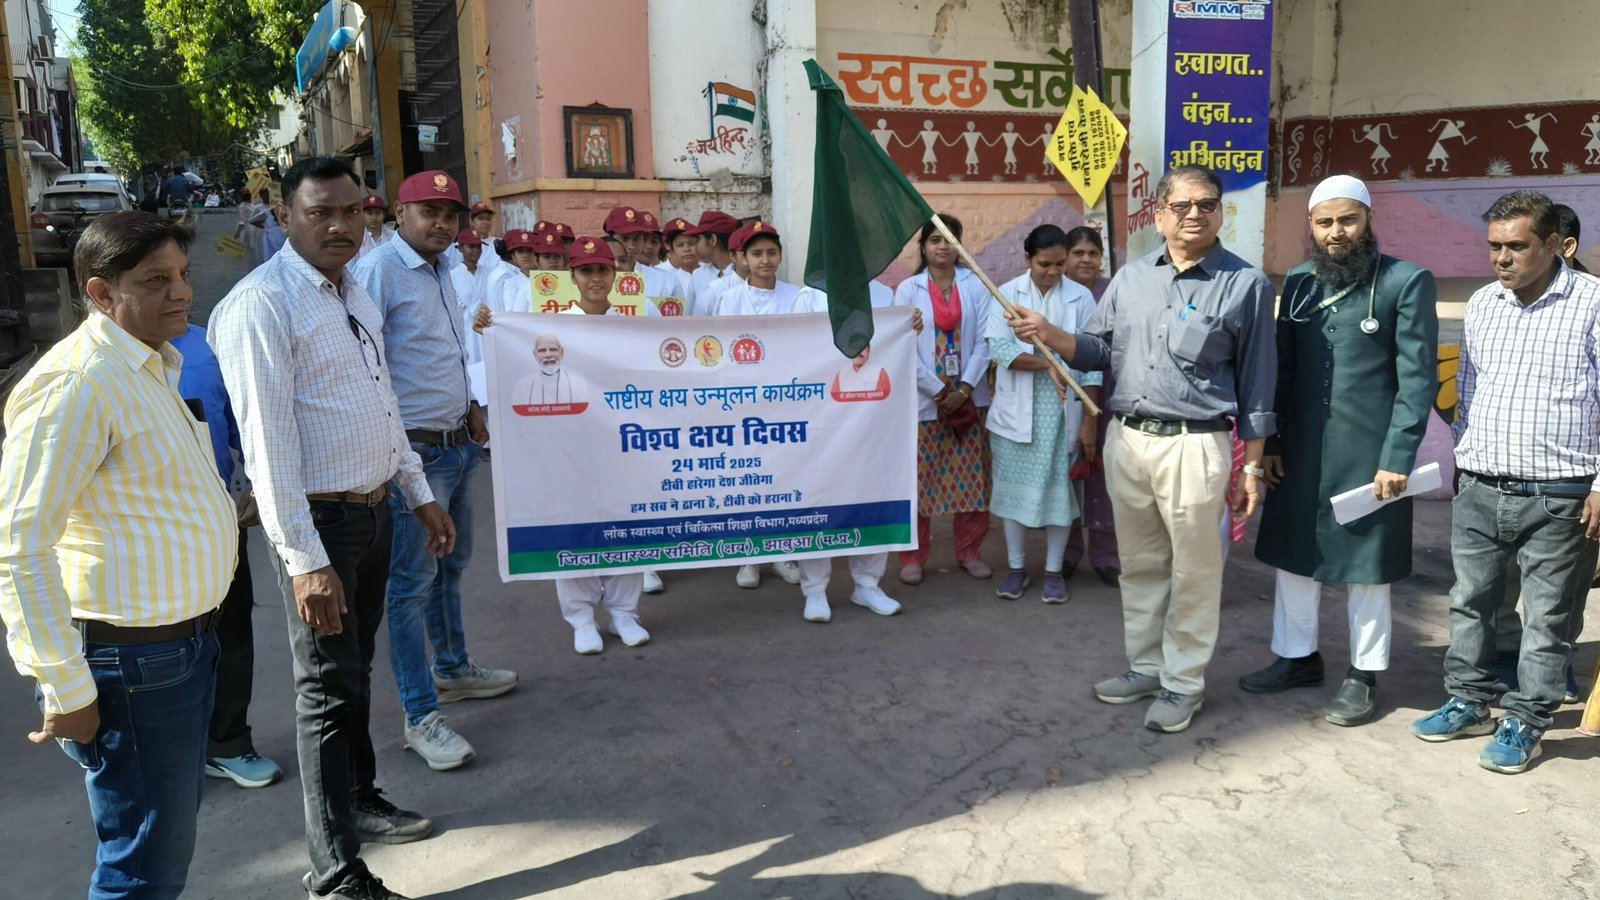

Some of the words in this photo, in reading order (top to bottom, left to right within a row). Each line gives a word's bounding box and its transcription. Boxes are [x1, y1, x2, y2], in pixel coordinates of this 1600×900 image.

[1175, 3, 1239, 13] RMM
[838, 52, 987, 109] स्वच्छ
[1065, 120, 1077, 139] एवं
[1089, 111, 1099, 138] 16788
[1095, 109, 1105, 138] 02046
[696, 137, 720, 156] जय
[717, 125, 748, 155] हिन्द
[1057, 134, 1066, 162] नशा
[1099, 140, 1108, 169] 99936
[1068, 141, 1081, 172] मुक्ति
[1092, 142, 1101, 170] 94791
[1169, 141, 1264, 173] अभिनंदन
[1132, 162, 1150, 198] नो
[659, 388, 688, 407] क्षय
[693, 386, 757, 411] उन्मूलन
[762, 377, 826, 401] कार्यक्रम
[620, 423, 681, 452] विश्व
[689, 424, 735, 448] क्षय
[742, 417, 808, 445] दिवस
[672, 458, 694, 472] 24
[698, 452, 726, 471] मार्च
[730, 457, 762, 469] 2025
[687, 476, 715, 490] हारेगा
[719, 474, 736, 487] देश
[739, 473, 773, 486] जीतेगा
[630, 503, 646, 513] हम
[670, 499, 679, 511] ने
[748, 493, 761, 505] को
[764, 492, 792, 504] हराना
[793, 490, 802, 502] है
[603, 526, 628, 540] लोक
[630, 526, 664, 539] स्वास्थ्य
[667, 522, 682, 538] एवं
[684, 520, 725, 534] चिकित्सा
[727, 518, 752, 532] शिक्षा
[557, 550, 600, 567] जिला
[602, 548, 662, 564] स्वास्थ्य
[664, 540, 713, 558] समिति
[763, 536, 813, 553] झाबुआ
